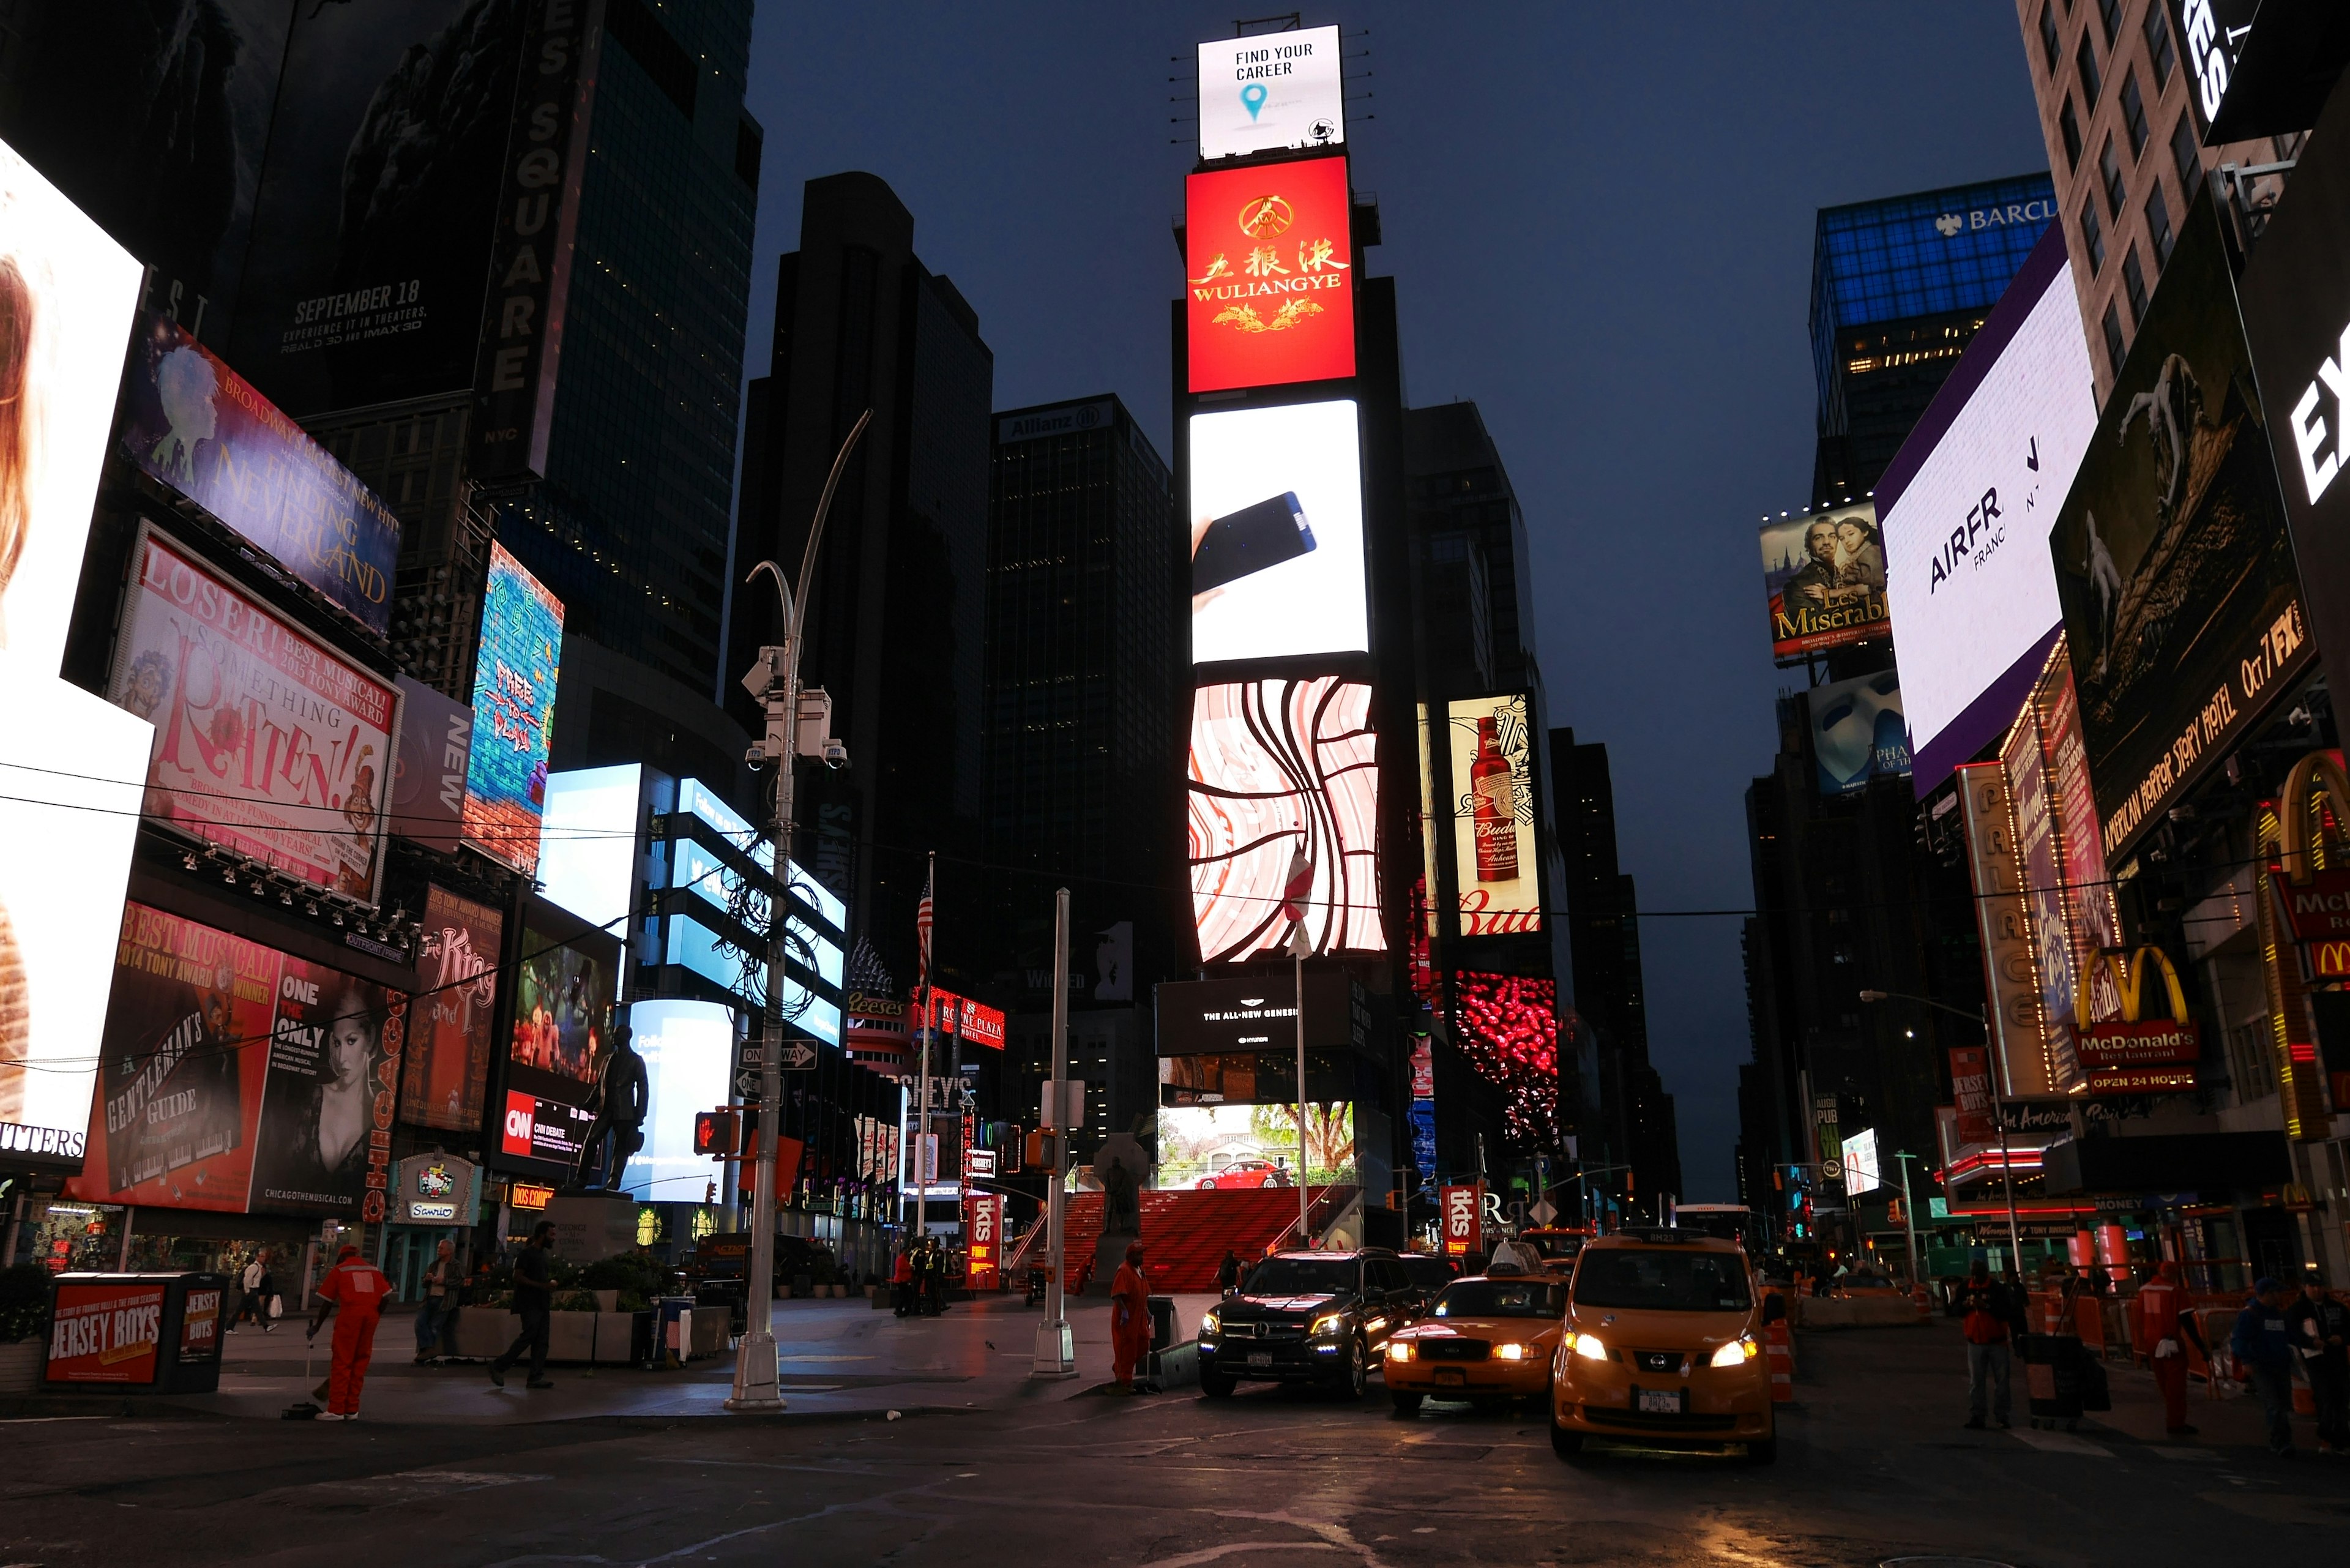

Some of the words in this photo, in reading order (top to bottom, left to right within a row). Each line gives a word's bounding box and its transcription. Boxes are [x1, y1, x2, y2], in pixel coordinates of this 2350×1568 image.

[1236, 49, 1269, 65] FIND
[1274, 43, 1313, 60] YOUR
[1236, 62, 1292, 81] CAREER
[491, 102, 559, 392] SQUARE
[1193, 273, 1342, 303] WULIANGYE
[294, 285, 391, 324] SEPTEMBER
[396, 279, 420, 305] 18
[283, 321, 341, 342] EXPERIENCE
[346, 319, 356, 330] IT
[360, 316, 370, 328] IN
[326, 335, 343, 346] 3D
[345, 332, 360, 342] AND
[364, 324, 399, 338] IMAX
[402, 320, 422, 331] 3D
[1011, 416, 1072, 437] Allianz
[225, 375, 302, 451] BROADWAY'S
[306, 441, 351, 491] BIGGEST
[351, 488, 377, 515] NEW
[266, 453, 358, 547] FINDING
[317, 476, 349, 508] MORRISON
[212, 442, 387, 605] NEVERLAND
[1822, 588, 1859, 610] Les
[145, 541, 278, 660] LOSER!
[283, 637, 321, 671] BEST
[324, 657, 387, 710] MUSICAL!
[1802, 633, 1835, 645] BROADWAY'S
[1841, 629, 1867, 638] IMPERIAL
[2260, 632, 2272, 679] 7
[2270, 605, 2302, 668] FX
[196, 624, 341, 729] SOMETHING
[280, 652, 307, 680] 2015
[308, 668, 341, 701] TONY
[340, 692, 384, 726] AWARD
[496, 657, 534, 706] FREE
[494, 708, 531, 753] PLAY
[439, 714, 469, 815] NEW
[828, 748, 841, 756] NYPD
[1882, 761, 1895, 769] OF
[2104, 790, 2143, 857] AMERICAN
[2139, 751, 2176, 815] HORROR
[2172, 715, 2202, 778] STORY
[2201, 682, 2238, 745] HOTEL
[171, 785, 209, 815] COMEDY
[212, 805, 223, 817] IN
[223, 808, 236, 822] AT
[263, 827, 278, 843] 400
[695, 791, 715, 820] Follow
[714, 810, 723, 826] us
[247, 805, 288, 831] FUNNIEST
[288, 822, 321, 848] MUSICAL
[429, 888, 444, 905] 2015
[443, 893, 460, 911] TONY
[459, 899, 480, 918] AWARD
[1979, 783, 2037, 1027] PALACE
[428, 902, 442, 913] BEST
[442, 906, 466, 924] REVIVAL
[466, 914, 474, 925] OF
[479, 921, 501, 935] MUSICAL
[121, 904, 179, 954] BEST
[179, 923, 274, 984] MUSICAL!
[144, 950, 176, 979] TONY
[176, 963, 214, 990] AWARD
[233, 977, 270, 1007] WINNER
[428, 927, 498, 1009] King
[282, 975, 320, 1006] ONE
[280, 999, 304, 1020] THE
[459, 984, 479, 1037] I
[848, 991, 906, 1017] Reese's
[1203, 1012, 1221, 1021] THE
[1223, 1010, 1262, 1021] ALL-NEW
[277, 1018, 325, 1049] ONLY
[961, 1028, 980, 1040] HOTEL
[977, 1017, 1002, 1036] PLAZA
[274, 1042, 283, 1050] THE
[2081, 1032, 2195, 1051] McDonald's
[2100, 1048, 2176, 1061] Restaurant
[121, 1055, 136, 1075] A
[273, 1052, 295, 1063] AMERICAN
[295, 1057, 311, 1067] MUSICAL
[781, 1049, 806, 1061] WAY
[107, 1010, 203, 1134] GENTLEMAN'S
[277, 1062, 301, 1072] BROADWAY
[301, 1067, 318, 1077] HISTORY
[2094, 1077, 2128, 1088] OPEN
[2132, 1076, 2147, 1086] 24
[2150, 1073, 2193, 1086] HOURS
[742, 1078, 756, 1091] ONE
[1952, 1073, 1989, 1095] JERSEY
[146, 1088, 196, 1125] GUIDE
[361, 988, 409, 1223] CHICAGO
[406, 1097, 432, 1110] LINCOLN
[1960, 1091, 1989, 1111] BOYS
[506, 1109, 532, 1140] CNN
[1816, 1108, 1838, 1124] PUB
[534, 1122, 546, 1134] CNN
[545, 1124, 566, 1140] DEBATE
[265, 1188, 352, 1206] CHICAGOTHEMUSICAL.COM
[514, 1187, 529, 1205] DOS
[1483, 1192, 1512, 1225] R
[2095, 1197, 2143, 1211] MONEY
[975, 1198, 996, 1242] tkts
[1449, 1189, 1474, 1238] tkts
[558, 1223, 588, 1233] GEORGE
[2030, 1226, 2048, 1234] TONY
[2048, 1225, 2076, 1234] AWARDS
[62, 1306, 75, 1318] STORY
[100, 1299, 114, 1311] VALLI
[118, 1297, 127, 1308] THE
[127, 1295, 140, 1307] FOUR
[140, 1292, 161, 1304] SEASONS
[185, 1291, 221, 1314] JERSEY
[49, 1312, 111, 1361] JERSEY
[113, 1304, 160, 1349] BOYS
[188, 1319, 214, 1341] BOYS
